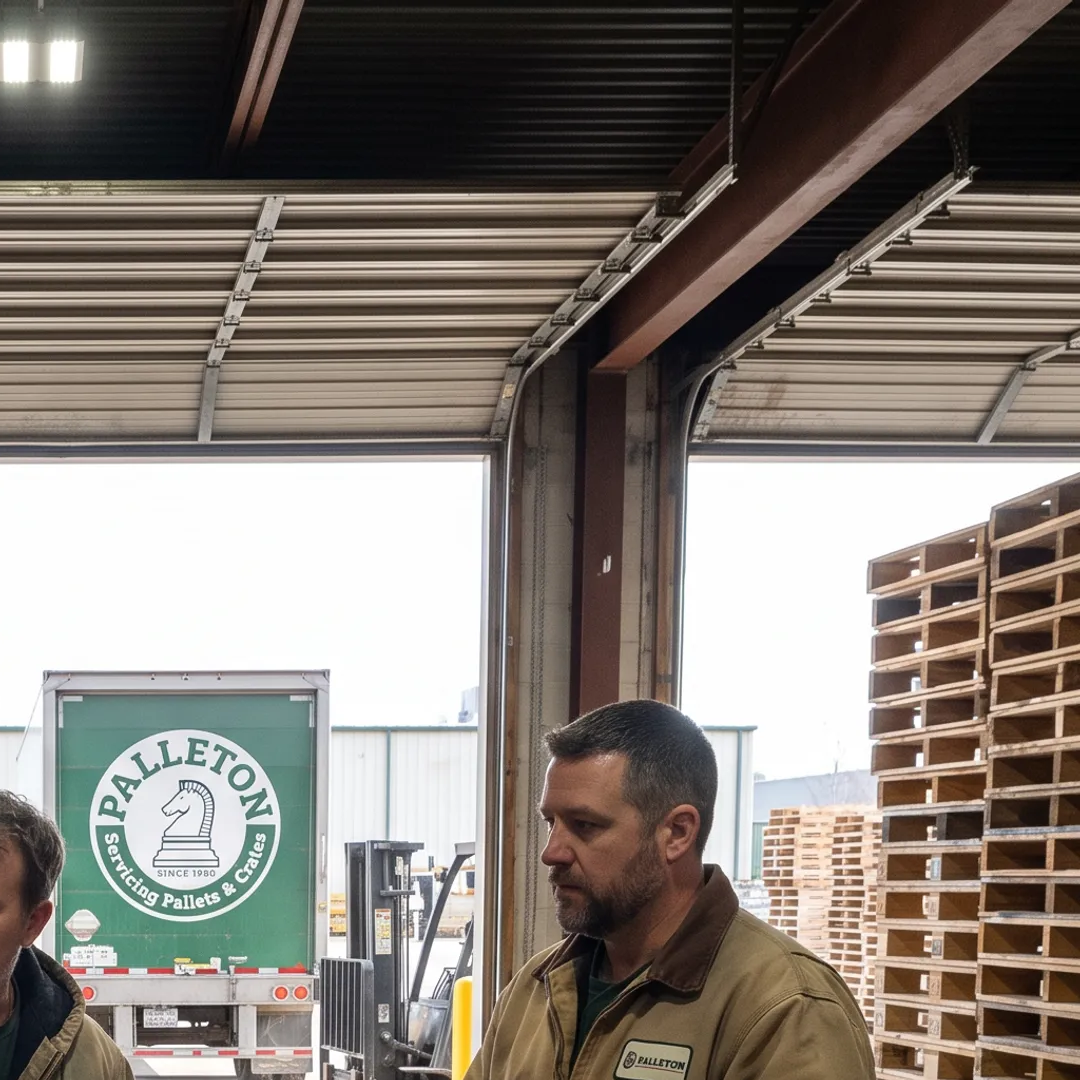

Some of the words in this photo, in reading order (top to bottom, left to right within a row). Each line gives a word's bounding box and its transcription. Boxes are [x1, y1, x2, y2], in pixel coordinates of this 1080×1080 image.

[98, 737, 273, 822] PALLETON
[104, 832, 160, 907] Servicing
[161, 892, 221, 910] Pallets
[221, 881, 237, 896] &
[157, 869, 189, 878] SINCE
[192, 869, 216, 878] 1980
[638, 1056, 686, 1070] PALLETON
